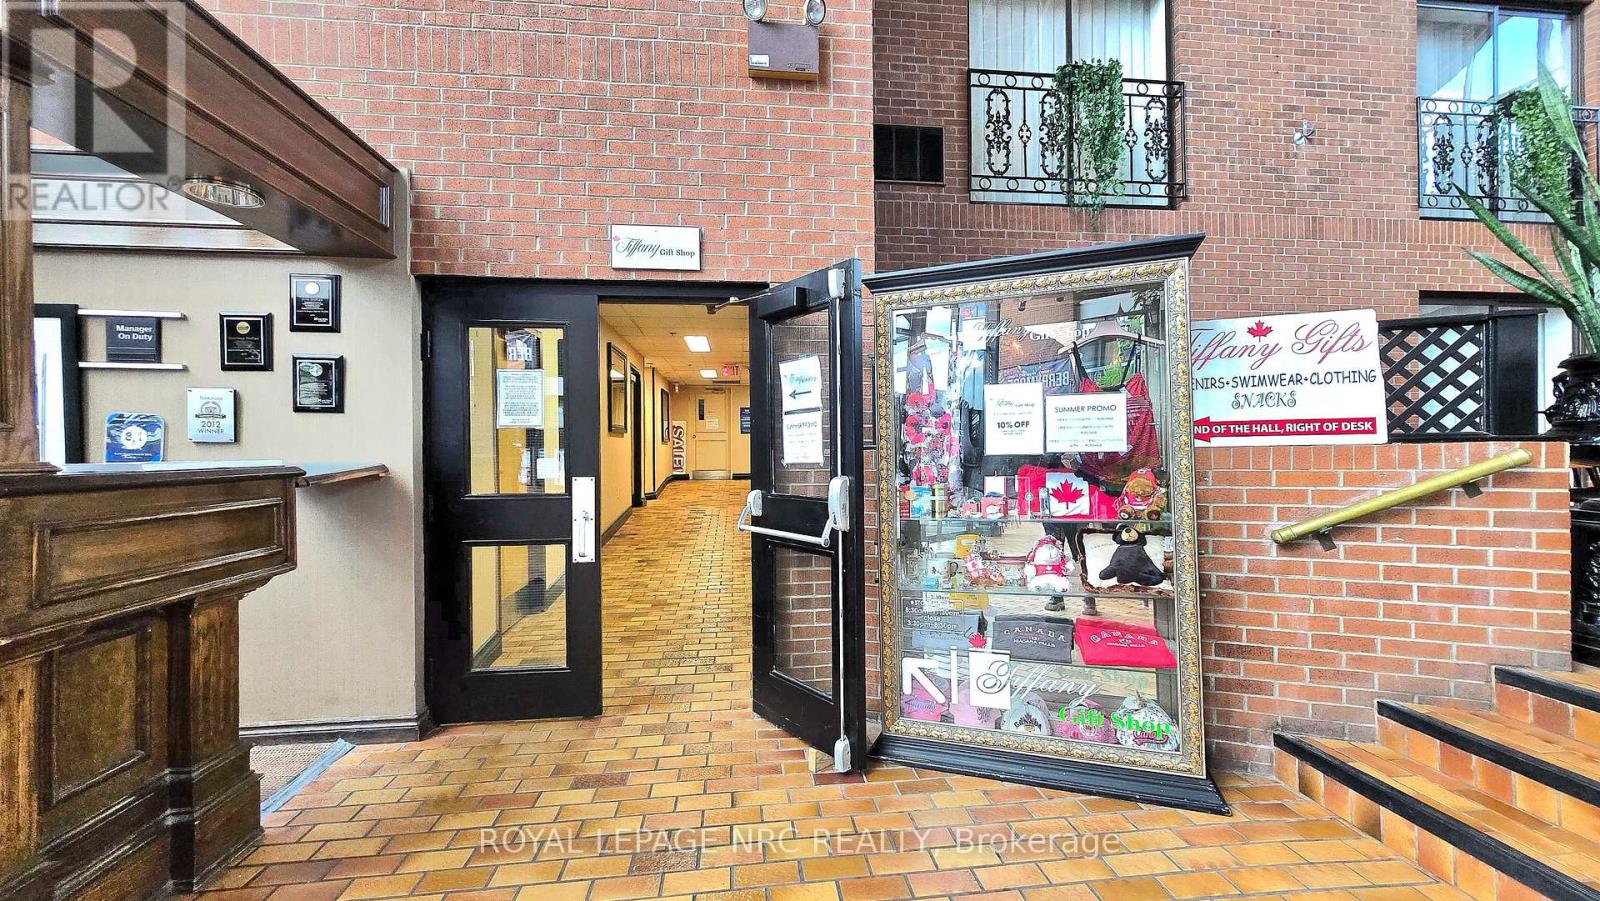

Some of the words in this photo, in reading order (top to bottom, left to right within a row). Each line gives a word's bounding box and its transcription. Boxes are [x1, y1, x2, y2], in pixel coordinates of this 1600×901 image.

[615, 237, 661, 259] Tiffany
[660, 248, 674, 256] Gift
[676, 248, 696, 258] Shop
[115, 324, 153, 334] Manager
[118, 332, 131, 340] On
[132, 332, 153, 342] Duty
[1291, 319, 1374, 364] Gifts
[1231, 373, 1302, 389] SWIMWEAR
[1309, 369, 1377, 385] CLOTHING
[1231, 390, 1297, 410] SNACKS
[1054, 406, 1085, 414] SUMMER
[1086, 404, 1117, 413] PROMO
[200, 420, 221, 428] 2012
[997, 421, 1013, 429] 10%
[1014, 420, 1030, 428] OFF
[1194, 425, 1210, 434] ND
[1212, 425, 1227, 433] OF
[1228, 424, 1250, 433] THE
[1252, 423, 1284, 434] HALL,
[1286, 422, 1321, 433] RIGHT
[1323, 422, 1339, 431] OF
[1341, 421, 1373, 431] DESK
[1003, 625, 1066, 642] CANADA
[976, 659, 1101, 708] Tiffany
[1111, 711, 1171, 740] Shop
